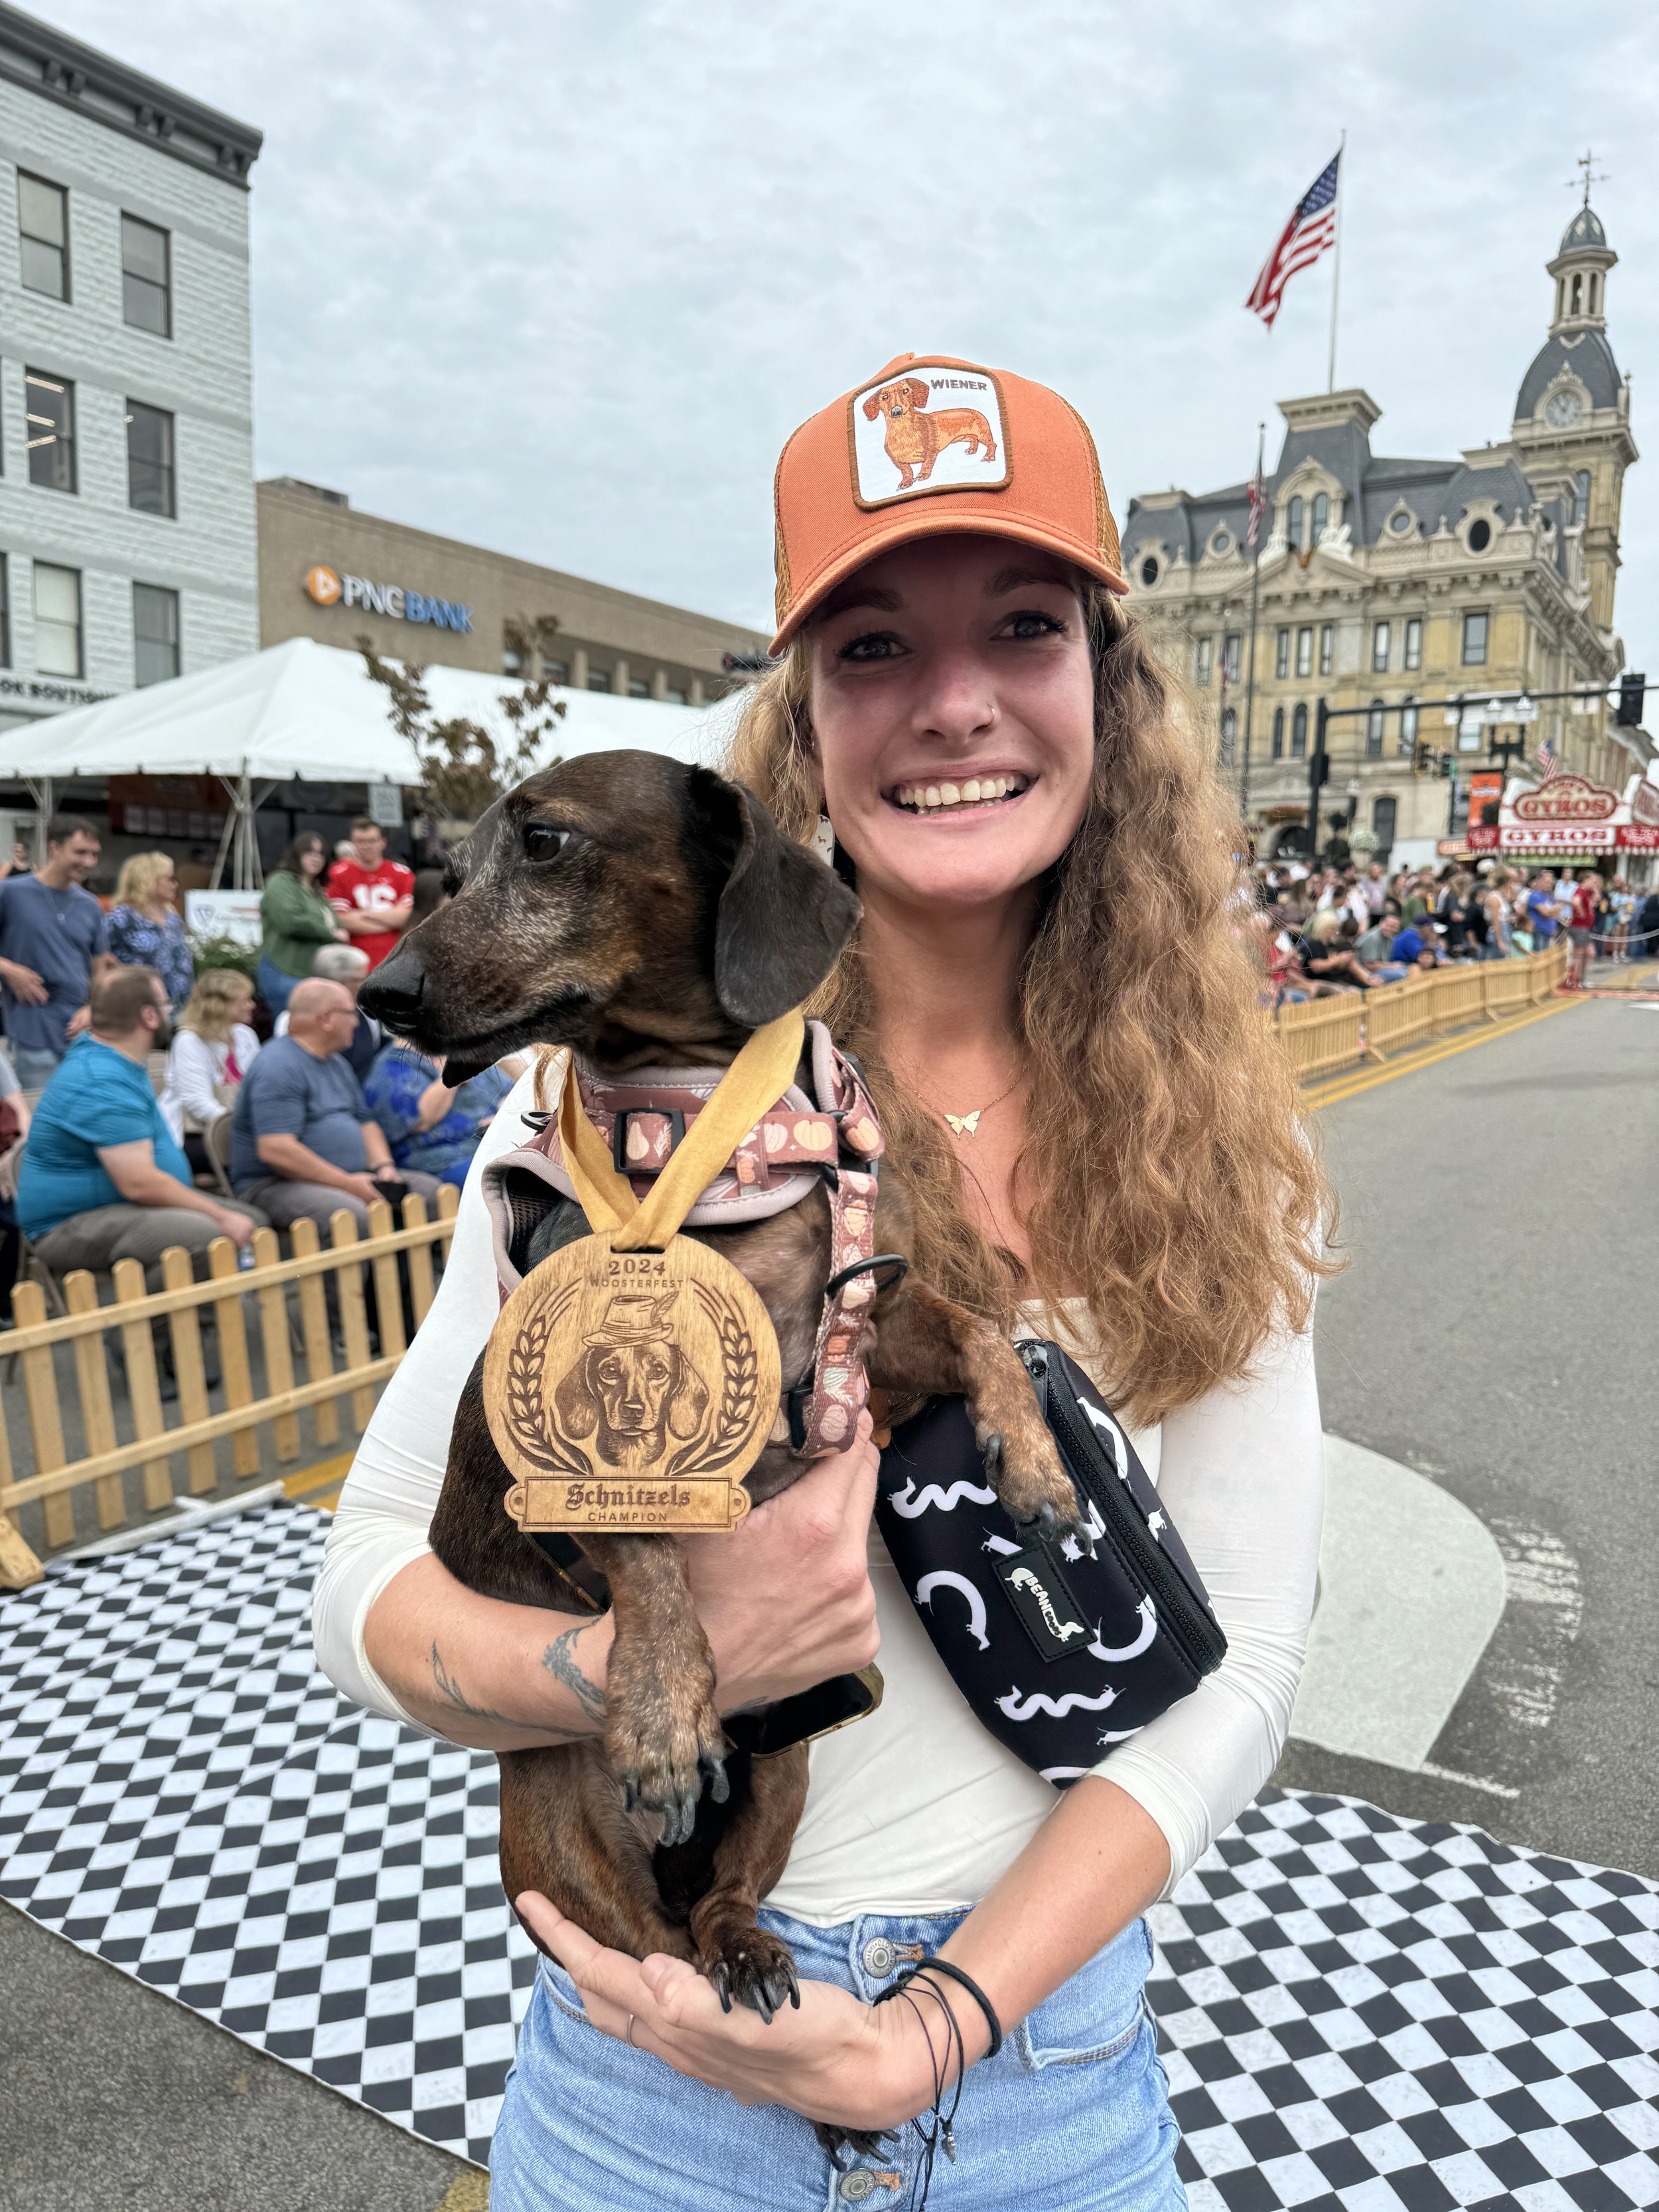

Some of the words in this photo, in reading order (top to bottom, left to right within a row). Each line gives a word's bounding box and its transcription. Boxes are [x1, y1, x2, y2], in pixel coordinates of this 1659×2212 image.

[930, 379, 987, 391] WIENER
[342, 573, 405, 619] PNC
[405, 590, 475, 633] BANK
[1522, 798, 1607, 813] GYROS
[1507, 830, 1608, 842] GYROS
[608, 1258, 666, 1276] 2024
[589, 1279, 684, 1288] WOOSTERFEST
[565, 1482, 691, 1511] Schnitzels
[588, 1512, 668, 1522] CHAMPION
[1025, 1576, 1052, 1610] BEAN
